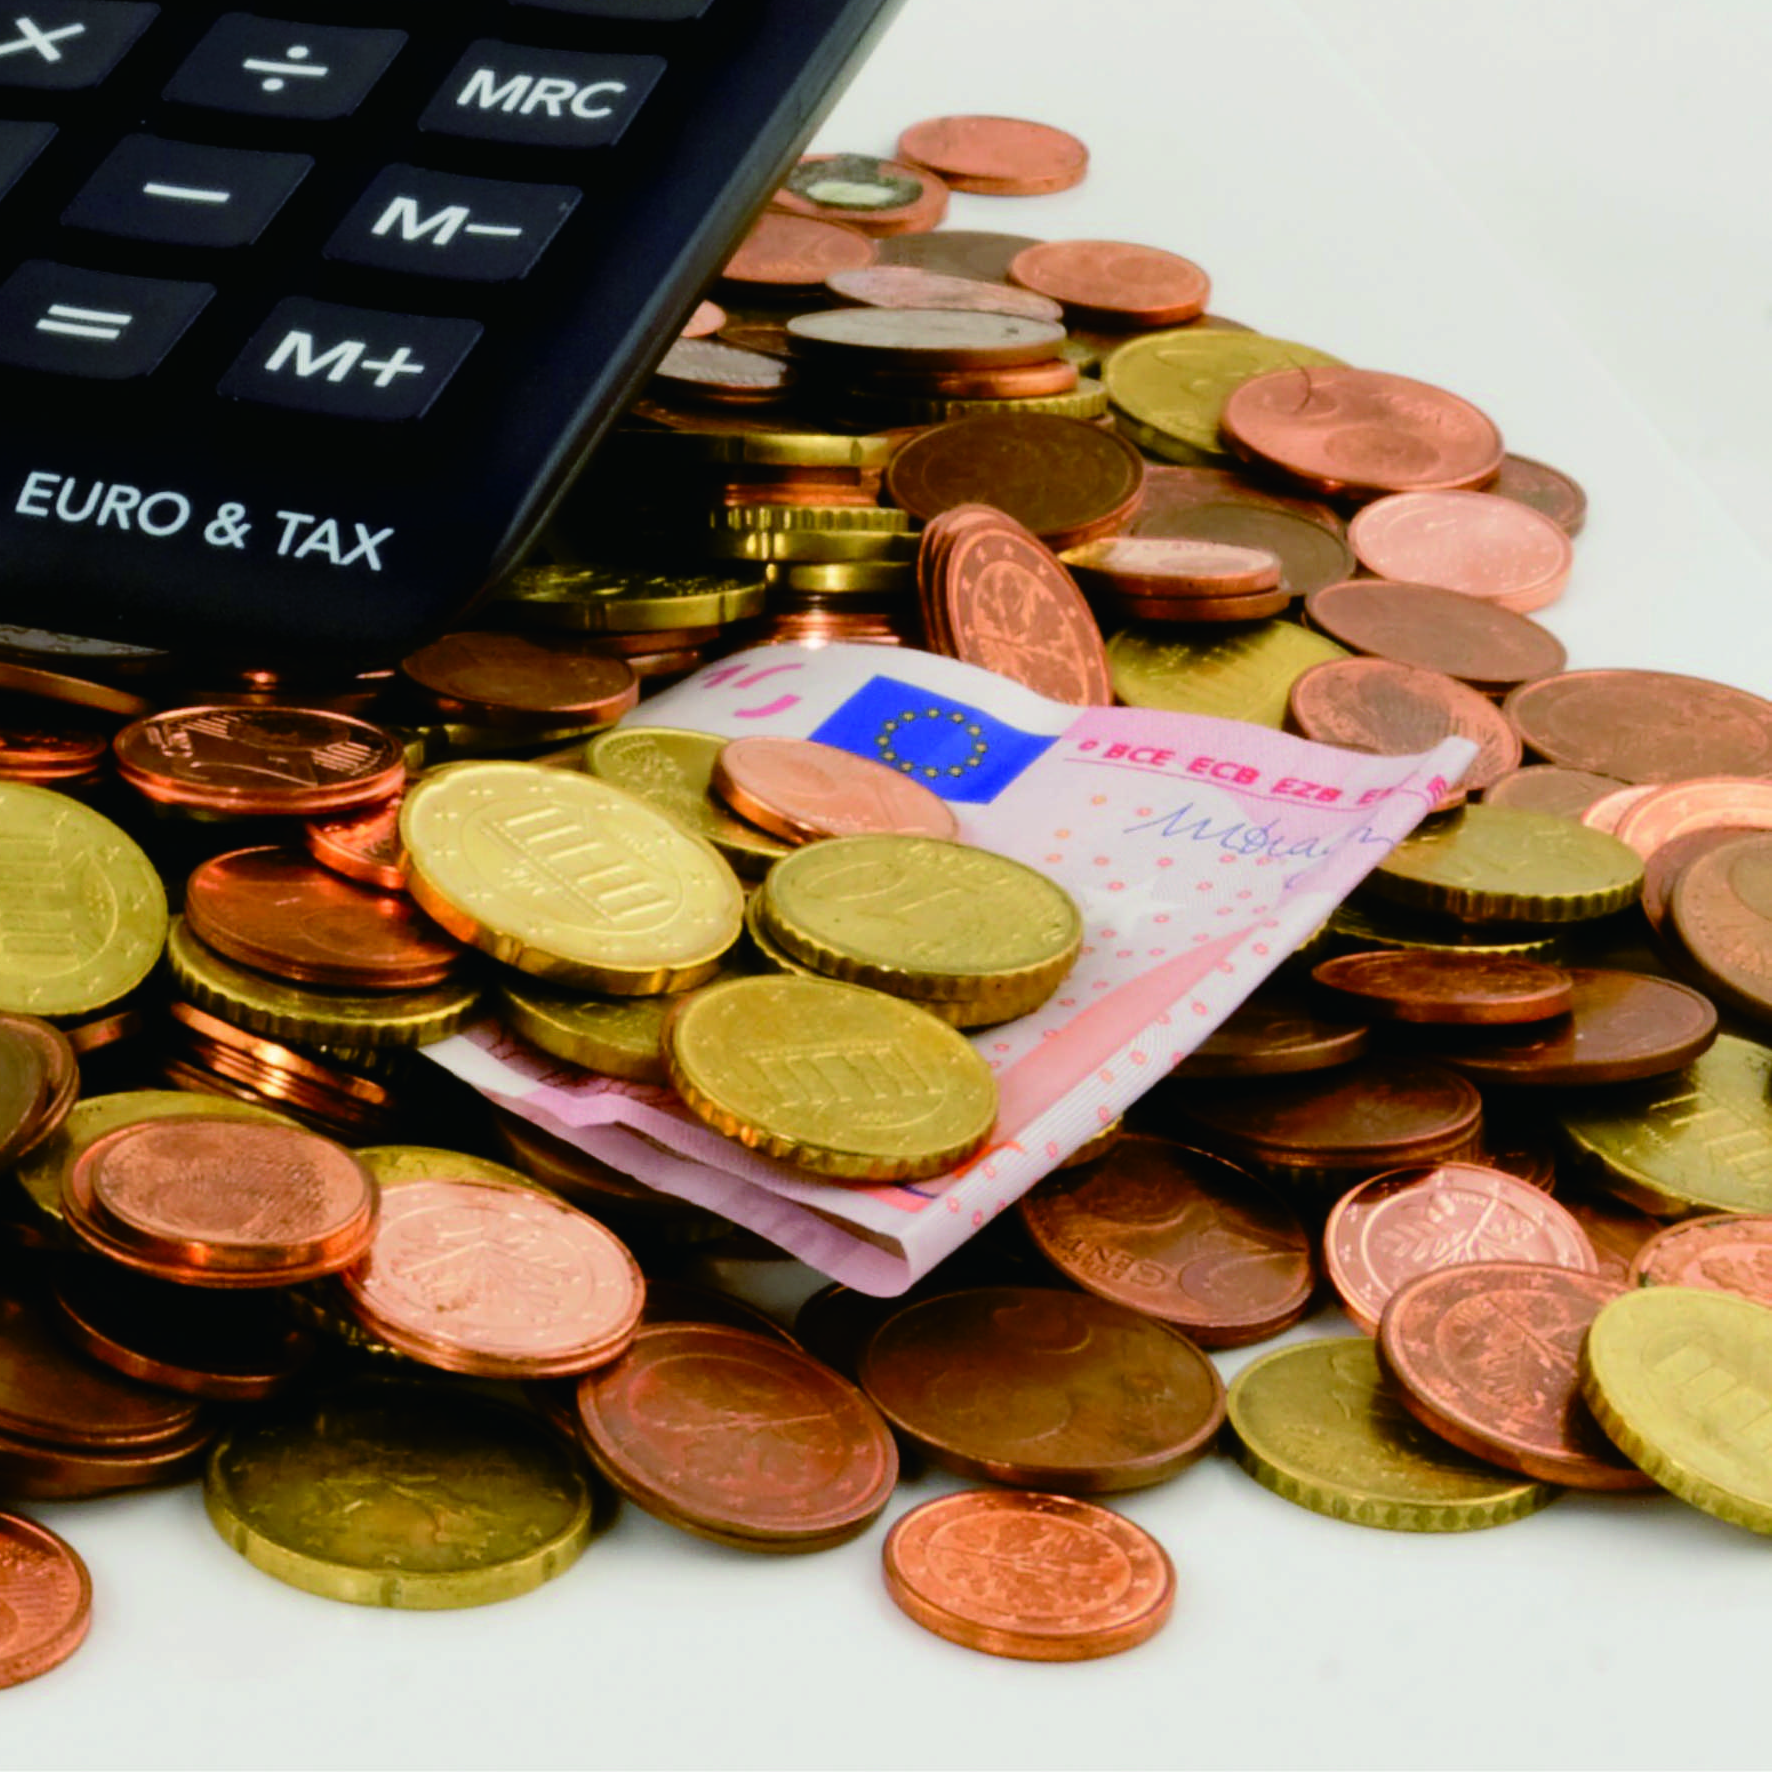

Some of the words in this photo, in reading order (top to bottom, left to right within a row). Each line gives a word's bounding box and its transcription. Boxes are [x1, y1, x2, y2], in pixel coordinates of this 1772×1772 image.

[457, 69, 626, 118] MRC
[265, 331, 424, 387] M+
[16, 472, 190, 536] EURO
[204, 502, 251, 548] &
[277, 511, 394, 571] TAX
[1102, 743, 1175, 768] BCE
[1187, 756, 1259, 786] ECB
[1270, 777, 1341, 803] EZB
[1062, 1233, 1167, 1290] CENT
